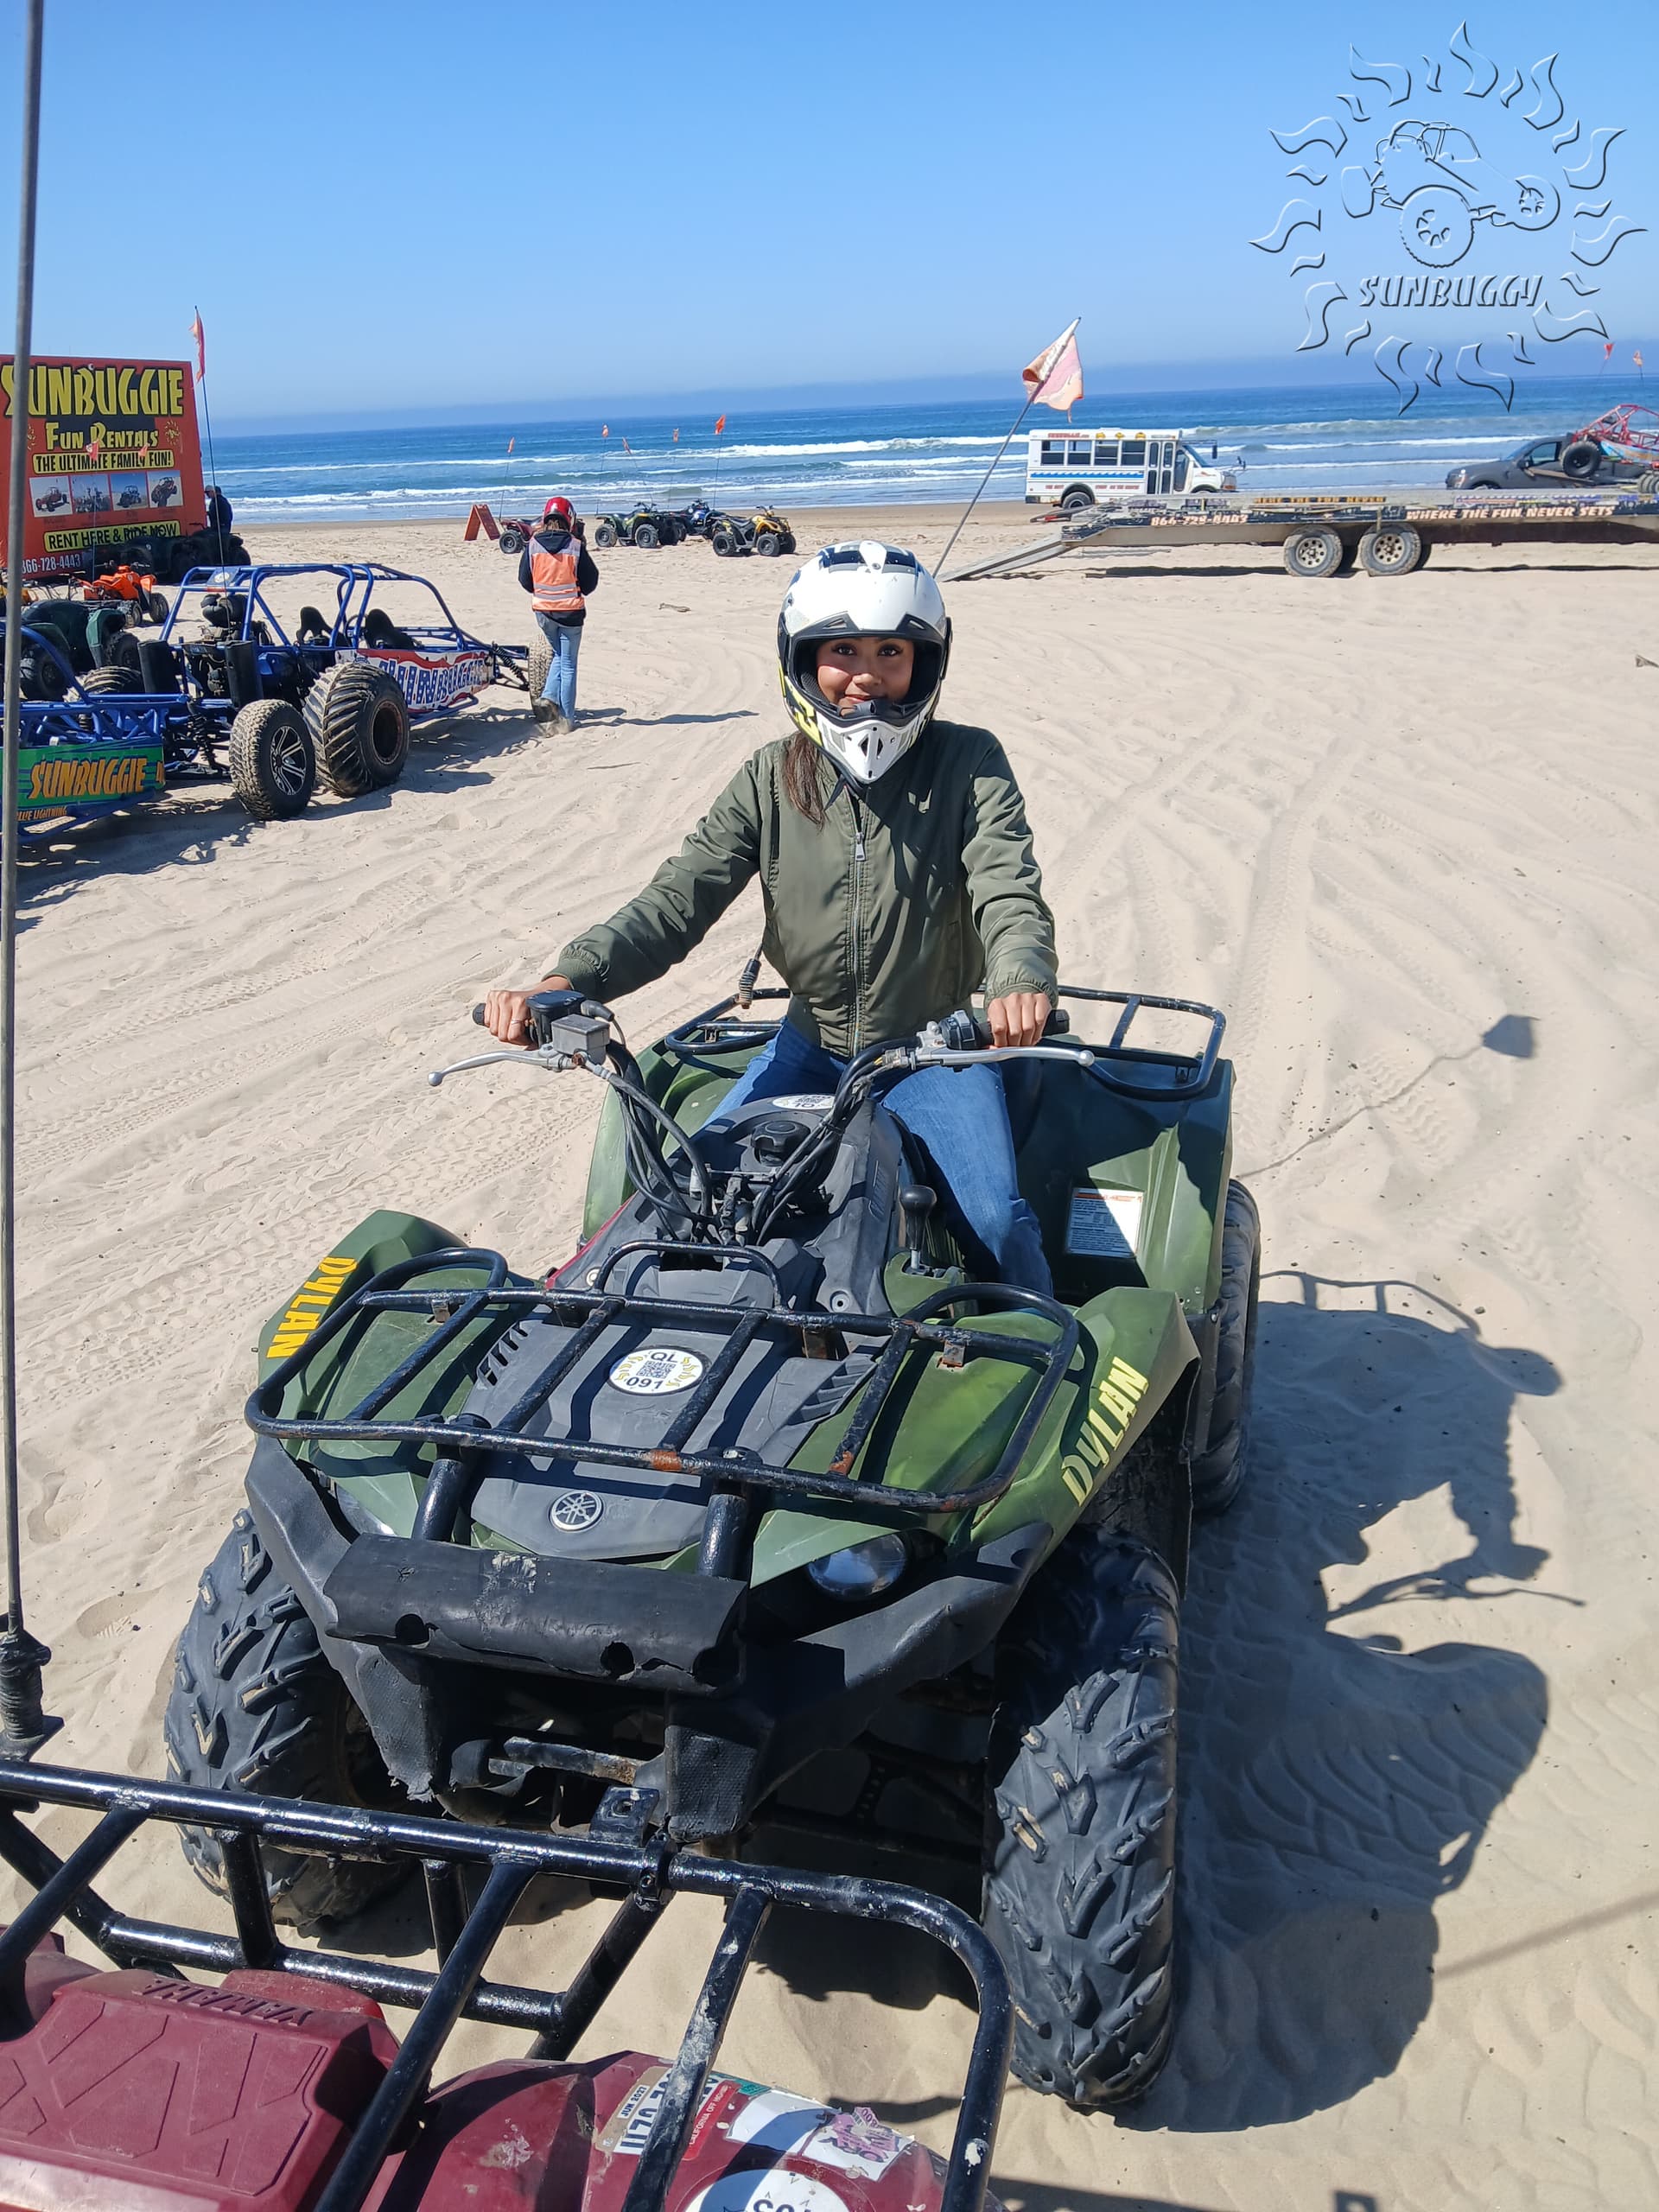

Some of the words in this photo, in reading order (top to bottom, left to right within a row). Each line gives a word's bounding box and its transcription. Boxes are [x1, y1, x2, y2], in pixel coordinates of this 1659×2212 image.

[1, 364, 183, 416] SUNBUGGIE
[36, 455, 57, 472] THE
[149, 450, 171, 467] FUN!
[1405, 509, 1458, 520] WHERE
[1460, 508, 1490, 518] THE
[1491, 508, 1522, 518] FUN
[1525, 506, 1575, 518] NEVER
[1579, 505, 1615, 517] SETS
[48, 532, 79, 550] RENT
[81, 529, 111, 547] HERE
[112, 528, 123, 543] &
[29, 757, 148, 799] SUNBUGGIE
[266, 1256, 359, 1359] DYLAN
[1061, 1356, 1150, 1507] DYLAN
[131, 1979, 314, 2027] YAMAHA
[620, 2101, 637, 2118] JUN
